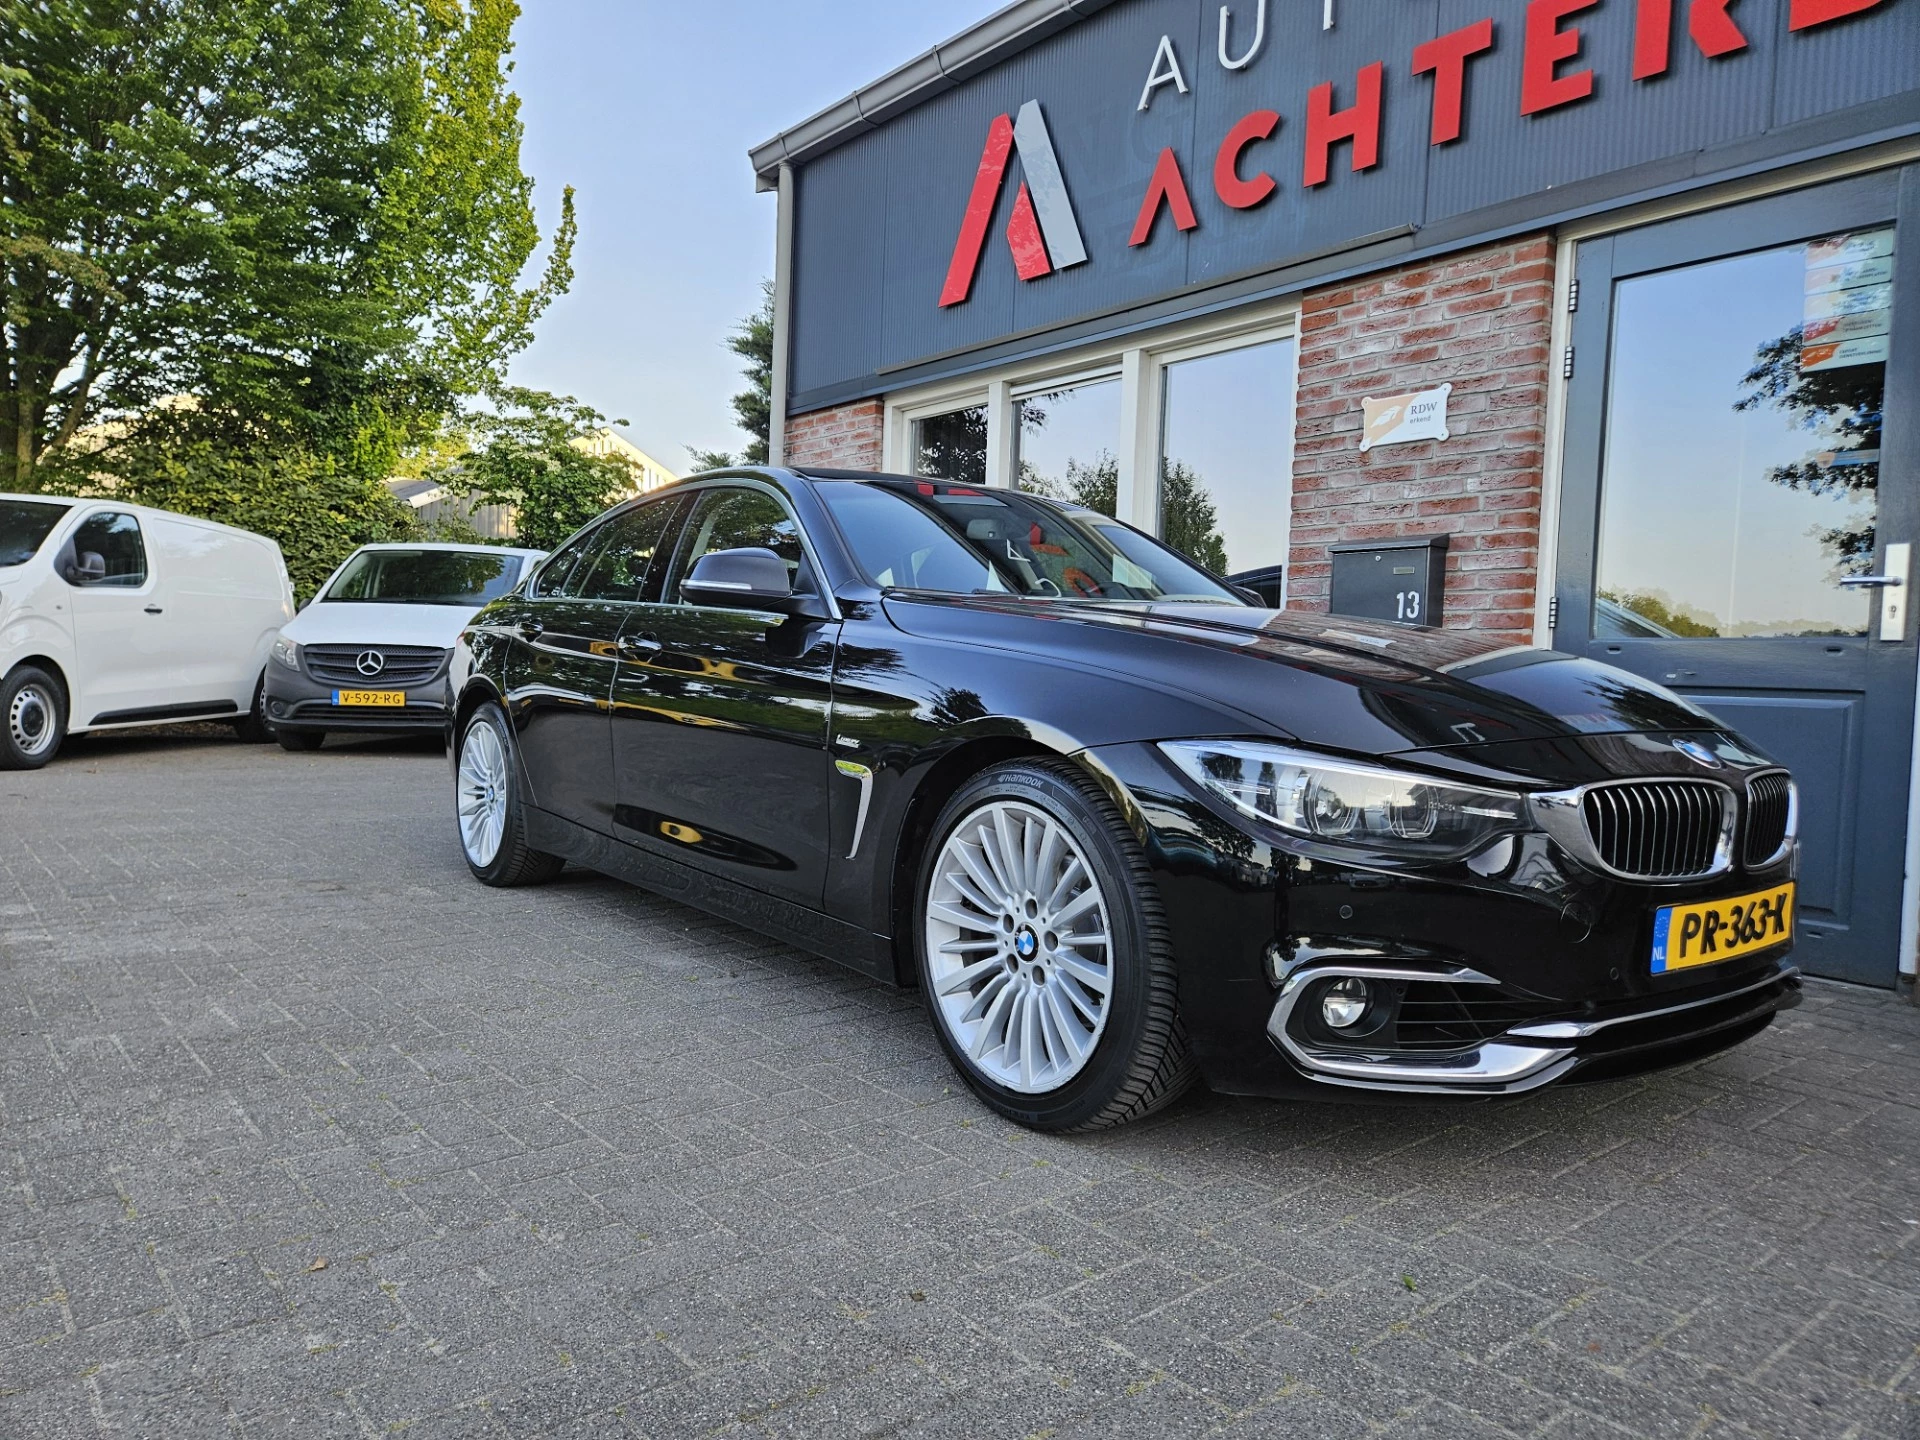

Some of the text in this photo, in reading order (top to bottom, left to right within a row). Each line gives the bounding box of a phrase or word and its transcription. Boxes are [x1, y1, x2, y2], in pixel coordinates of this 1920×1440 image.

[1128, 0, 1881, 248] ACHTER
[1411, 401, 1438, 415] RDW
[1410, 415, 1432, 424] erkend
[1396, 591, 1420, 619] 13
[342, 692, 401, 705] V-592-RG
[1679, 892, 1788, 959] PR-363-K
[1652, 946, 1665, 962] NL
